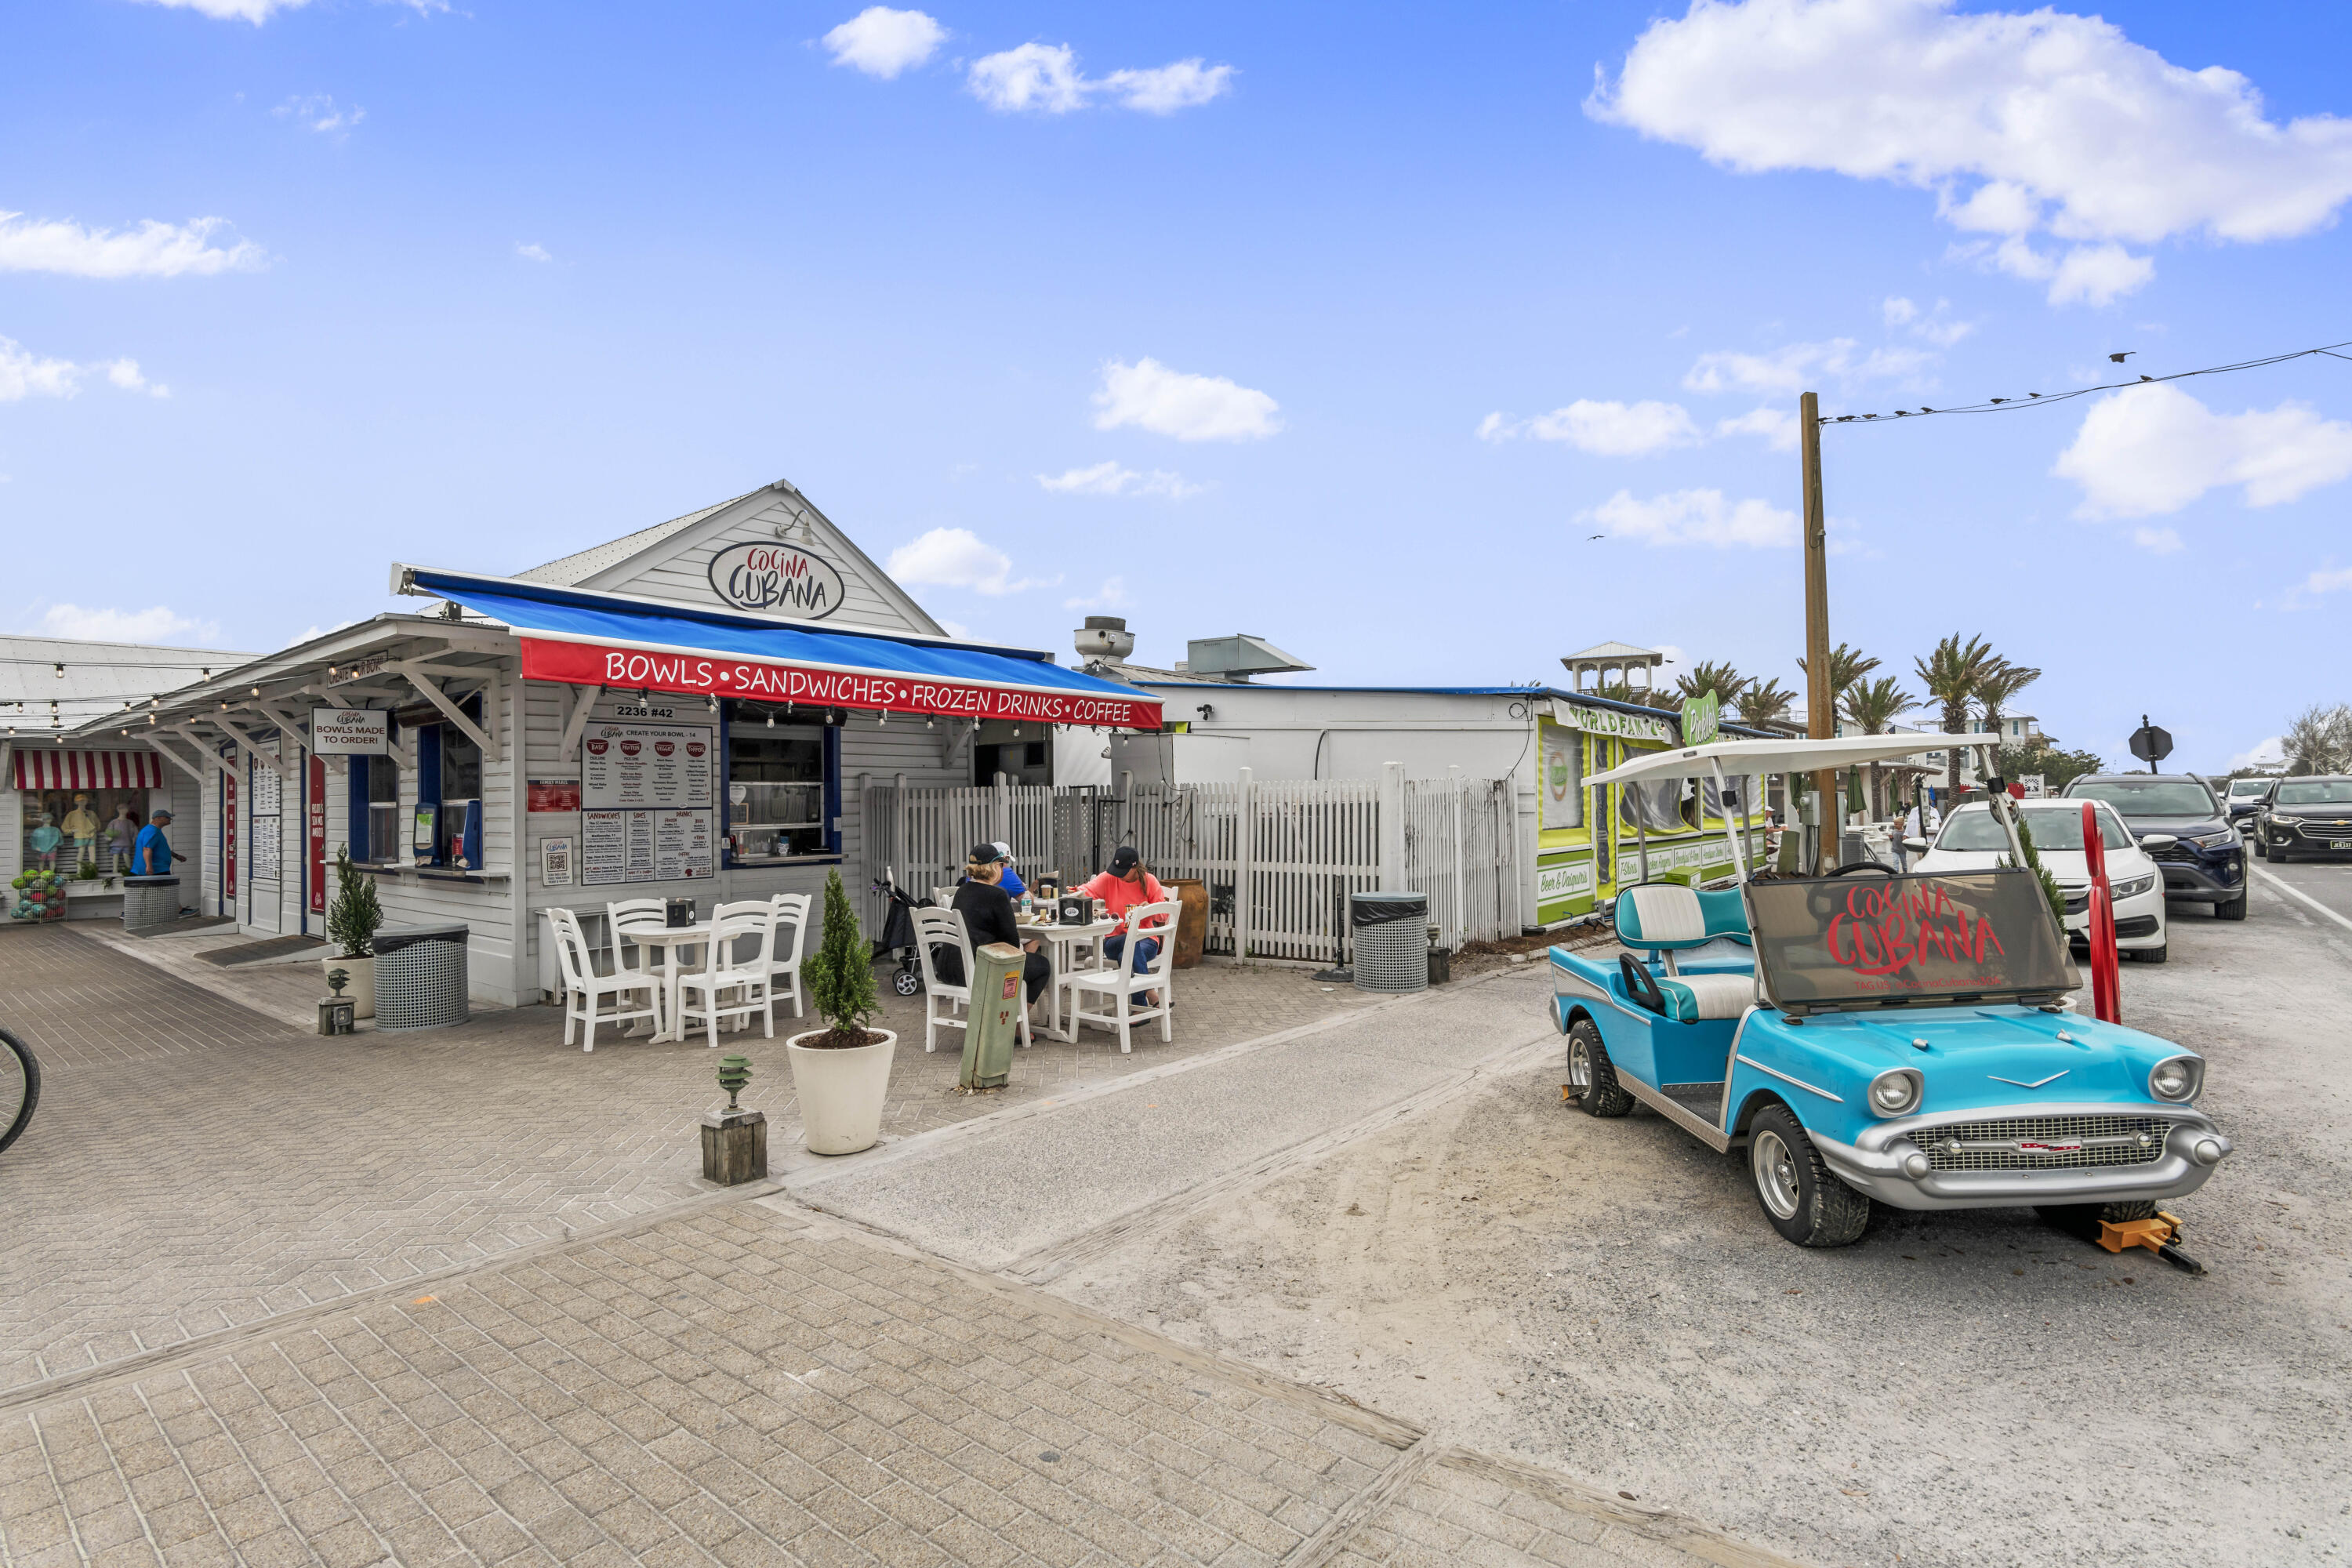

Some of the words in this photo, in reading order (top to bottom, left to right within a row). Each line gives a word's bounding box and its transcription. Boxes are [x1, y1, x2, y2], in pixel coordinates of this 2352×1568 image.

[747, 548, 808, 579] COCINA
[729, 564, 826, 610] CUBANA
[350, 662, 365, 678] YUR
[606, 652, 713, 686] BOWLS
[735, 666, 895, 704] SANDWICHES
[912, 685, 991, 711] FROZEN
[997, 692, 1062, 717] DRINKS
[1073, 699, 1131, 722] COFFEE
[336, 715, 365, 724] CUBANA
[617, 706, 648, 717] 2236
[652, 708, 673, 718] #42
[1619, 716, 1664, 735] FAMUS
[1541, 874, 1555, 892] Beer
[1555, 872, 1561, 889] &
[1562, 870, 1588, 891] Daiquiris
[1846, 882, 1955, 921] COCINA
[1828, 910, 2005, 975] CUBANA
[1854, 981, 1875, 991] TAG
[1896, 976, 2002, 990] @CocinaCubana30A
